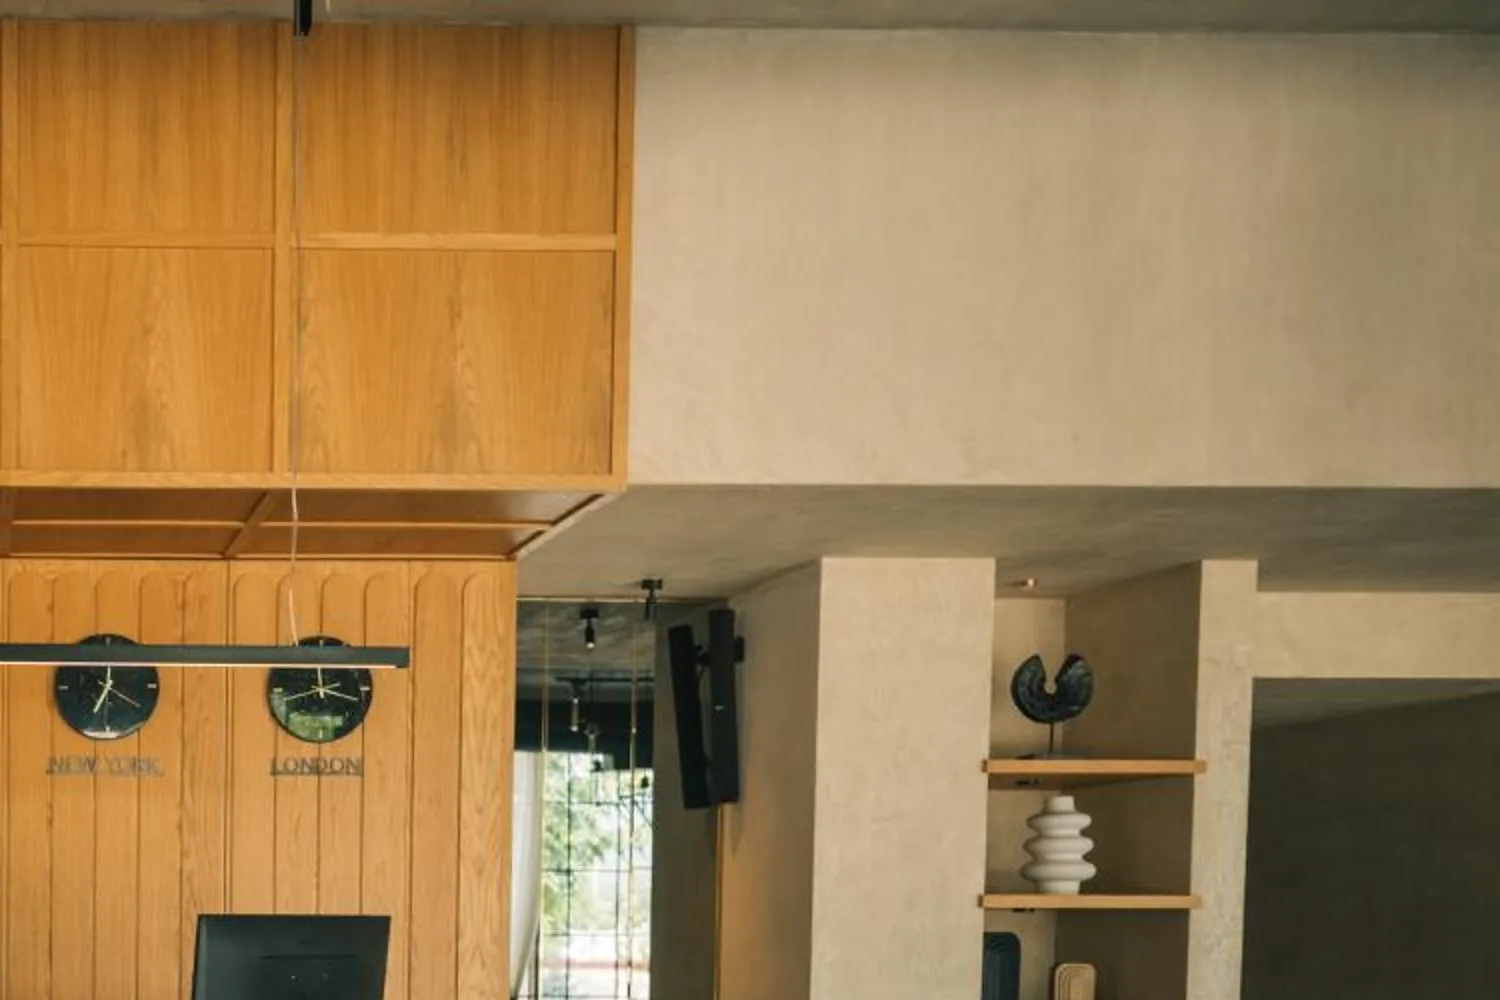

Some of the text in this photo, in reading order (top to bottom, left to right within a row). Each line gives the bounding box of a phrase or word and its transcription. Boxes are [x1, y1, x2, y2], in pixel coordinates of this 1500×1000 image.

[48, 755, 163, 776] NEW YORK
[271, 756, 363, 776] LONDON
